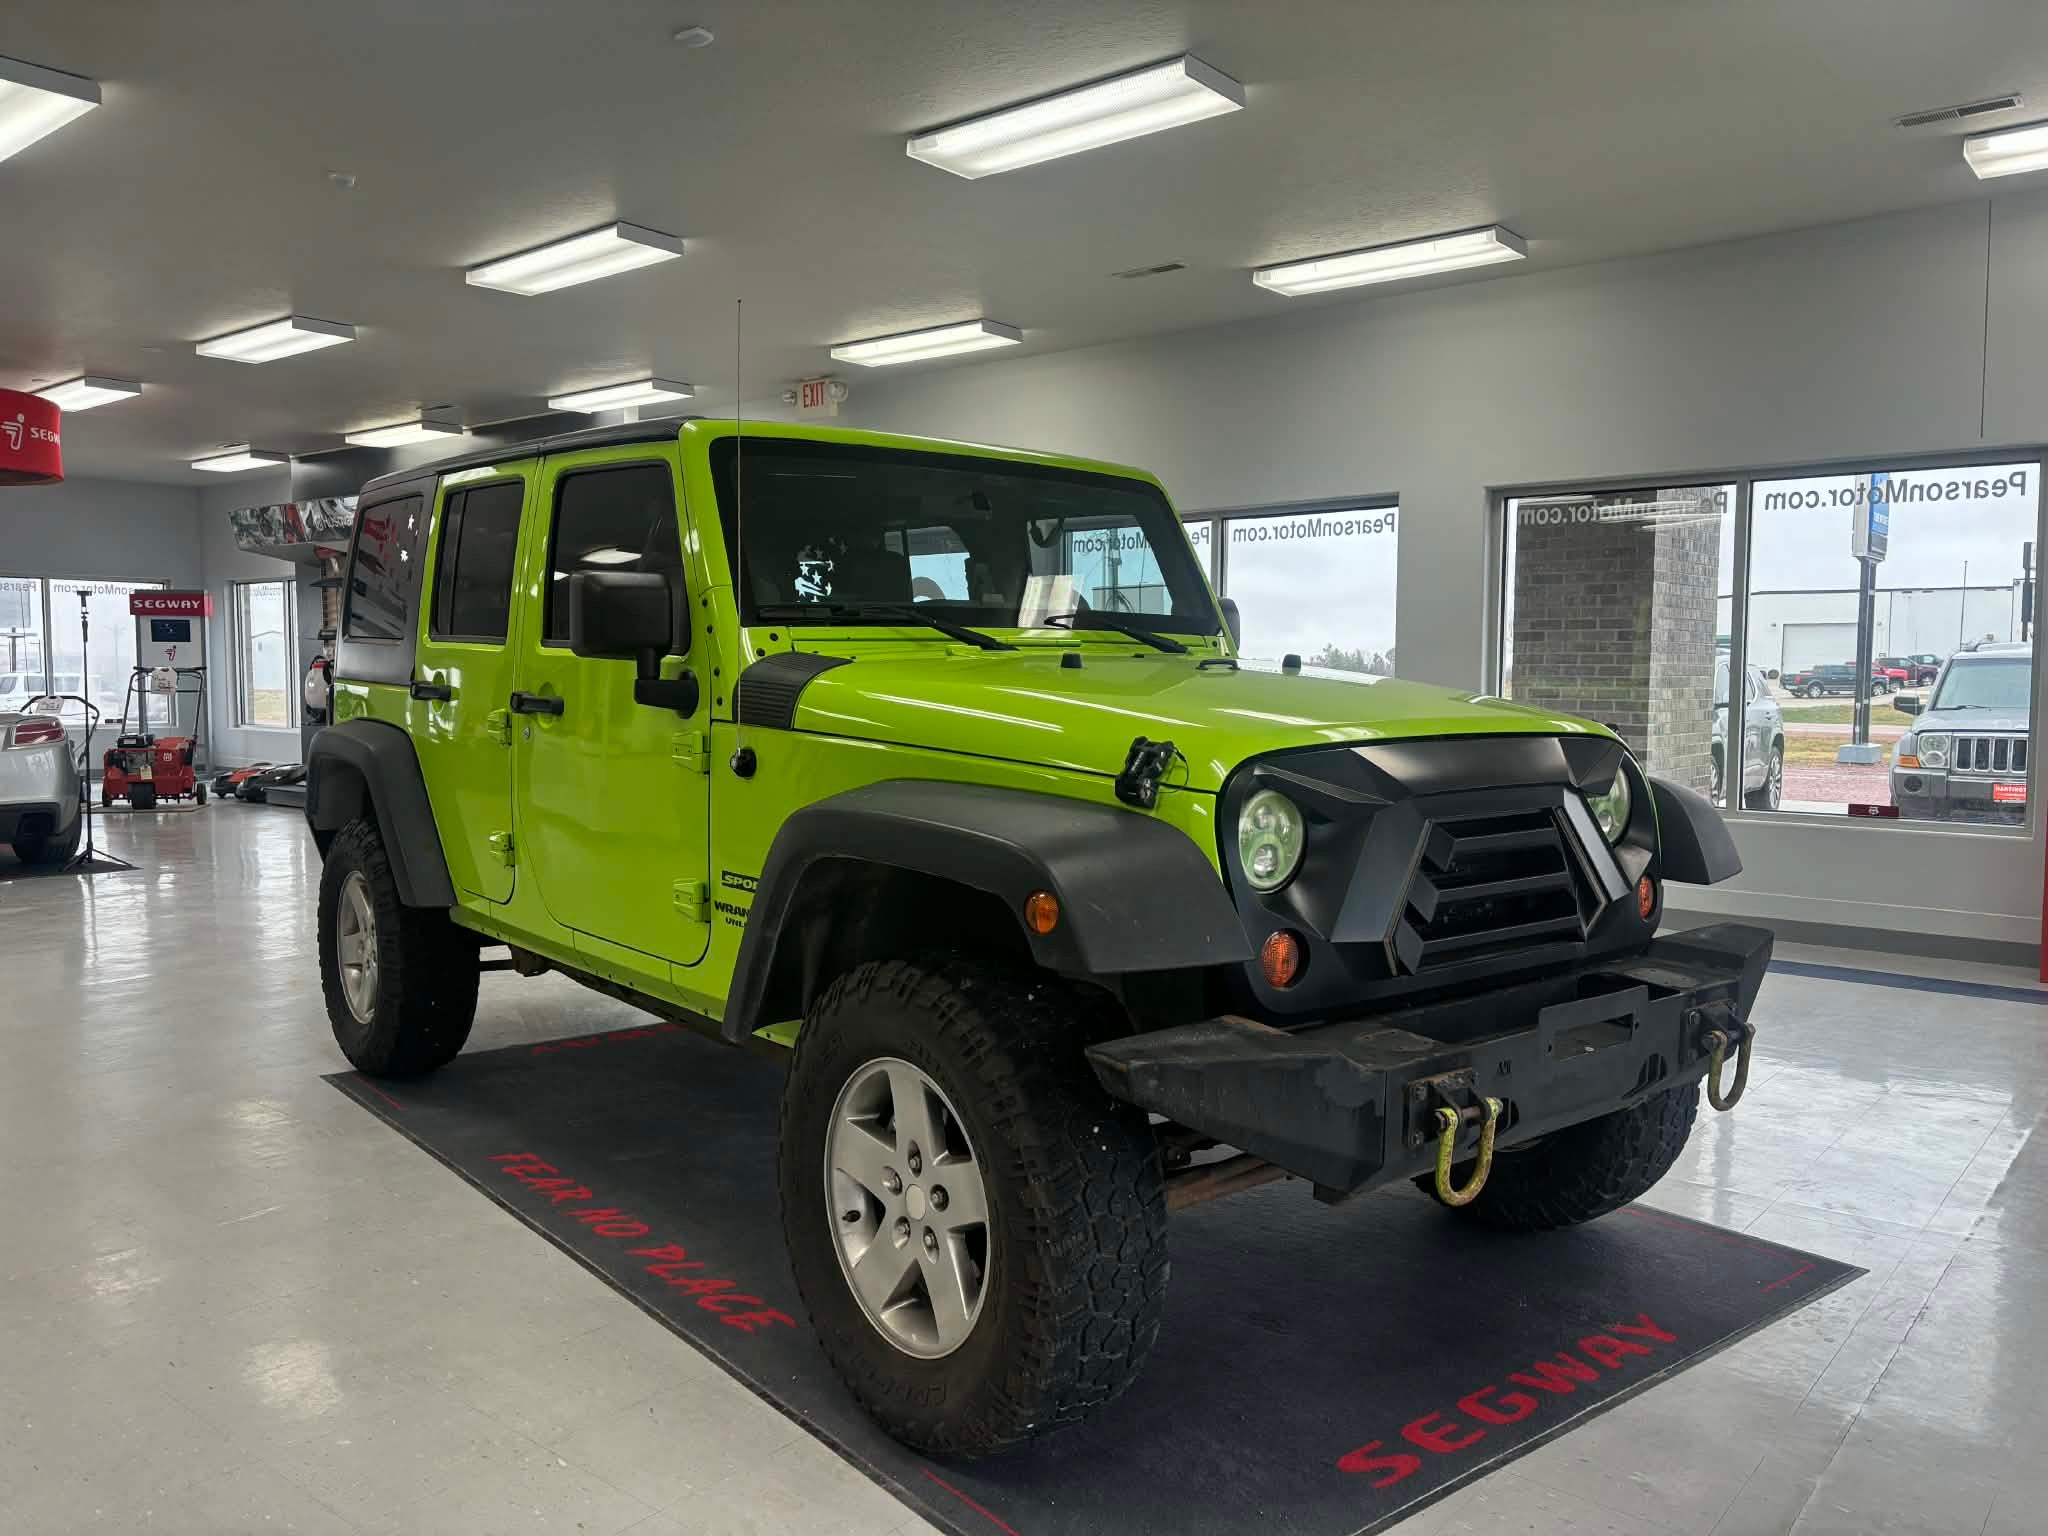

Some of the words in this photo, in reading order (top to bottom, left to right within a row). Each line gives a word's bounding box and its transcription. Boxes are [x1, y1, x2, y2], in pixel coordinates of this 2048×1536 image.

[802, 382, 825, 408] EXIT
[133, 600, 201, 609] SEGWAY
[486, 1152, 593, 1204] FEAR
[560, 1207, 649, 1238] NO
[625, 1242, 797, 1334] PLACE
[1337, 1313, 1677, 1489] SEGWAY
